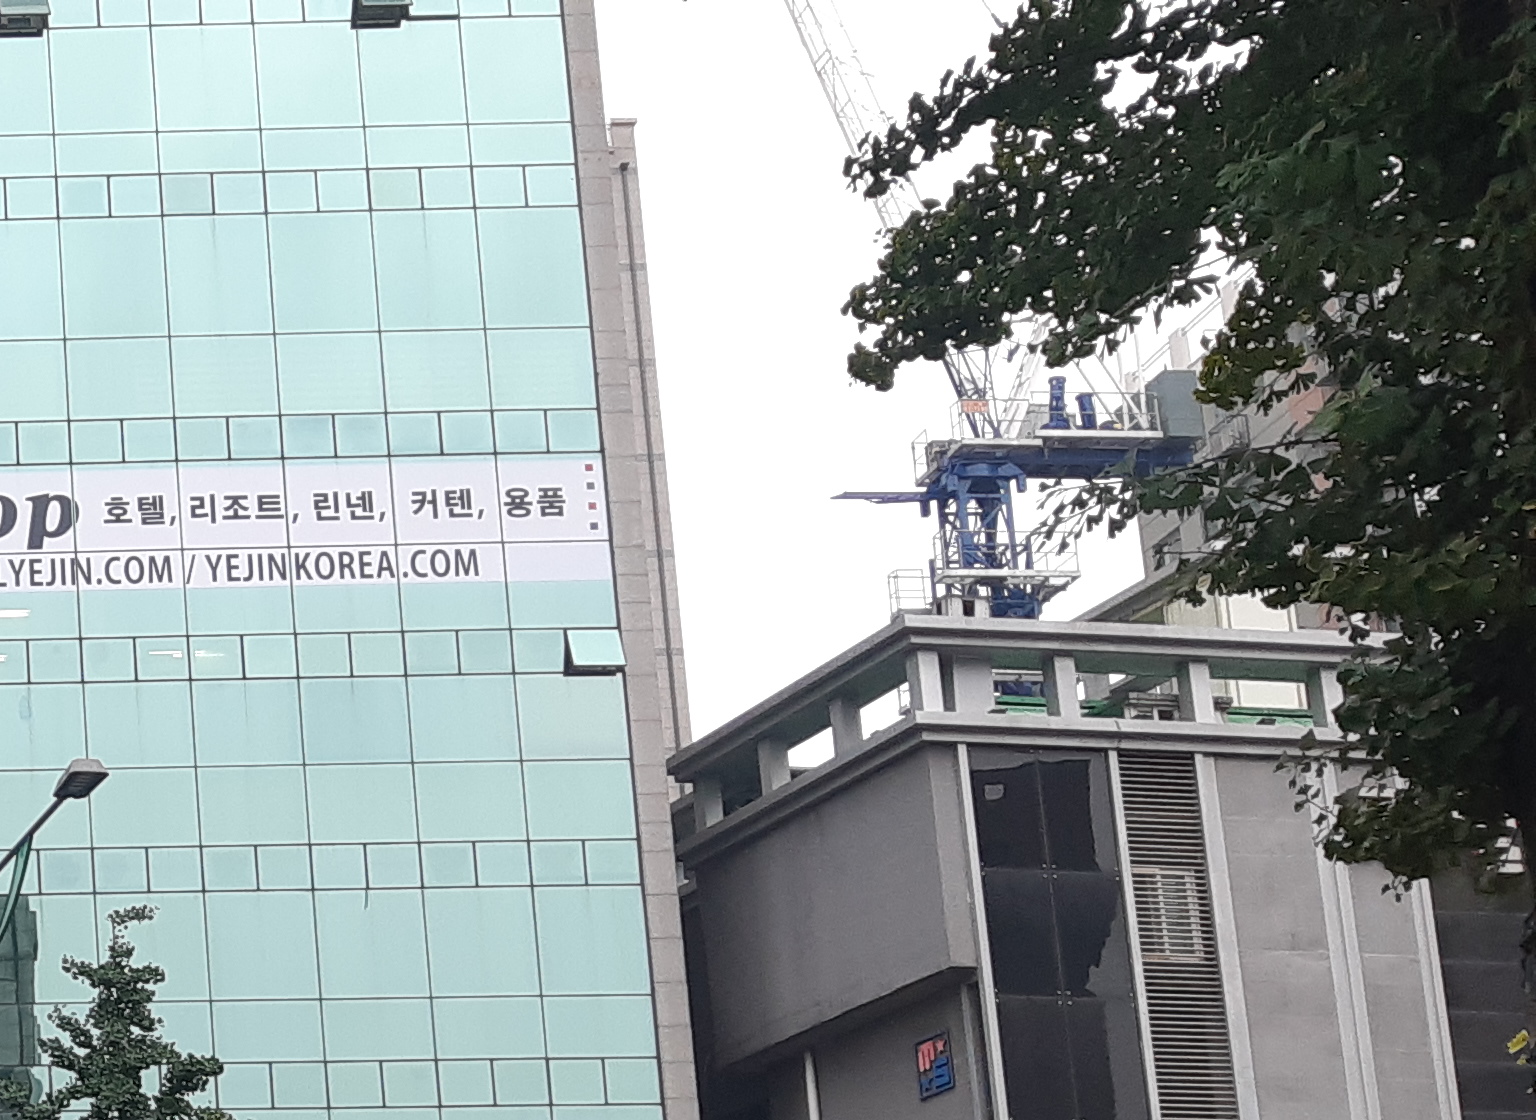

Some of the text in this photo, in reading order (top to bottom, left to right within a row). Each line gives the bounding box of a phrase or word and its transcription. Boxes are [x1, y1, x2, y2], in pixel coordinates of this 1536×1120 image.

[102, 487, 567, 527] 호텔, 리조트, 린넨, 커텐, 용품
[204, 548, 481, 584] YEJINKOREA.COM
